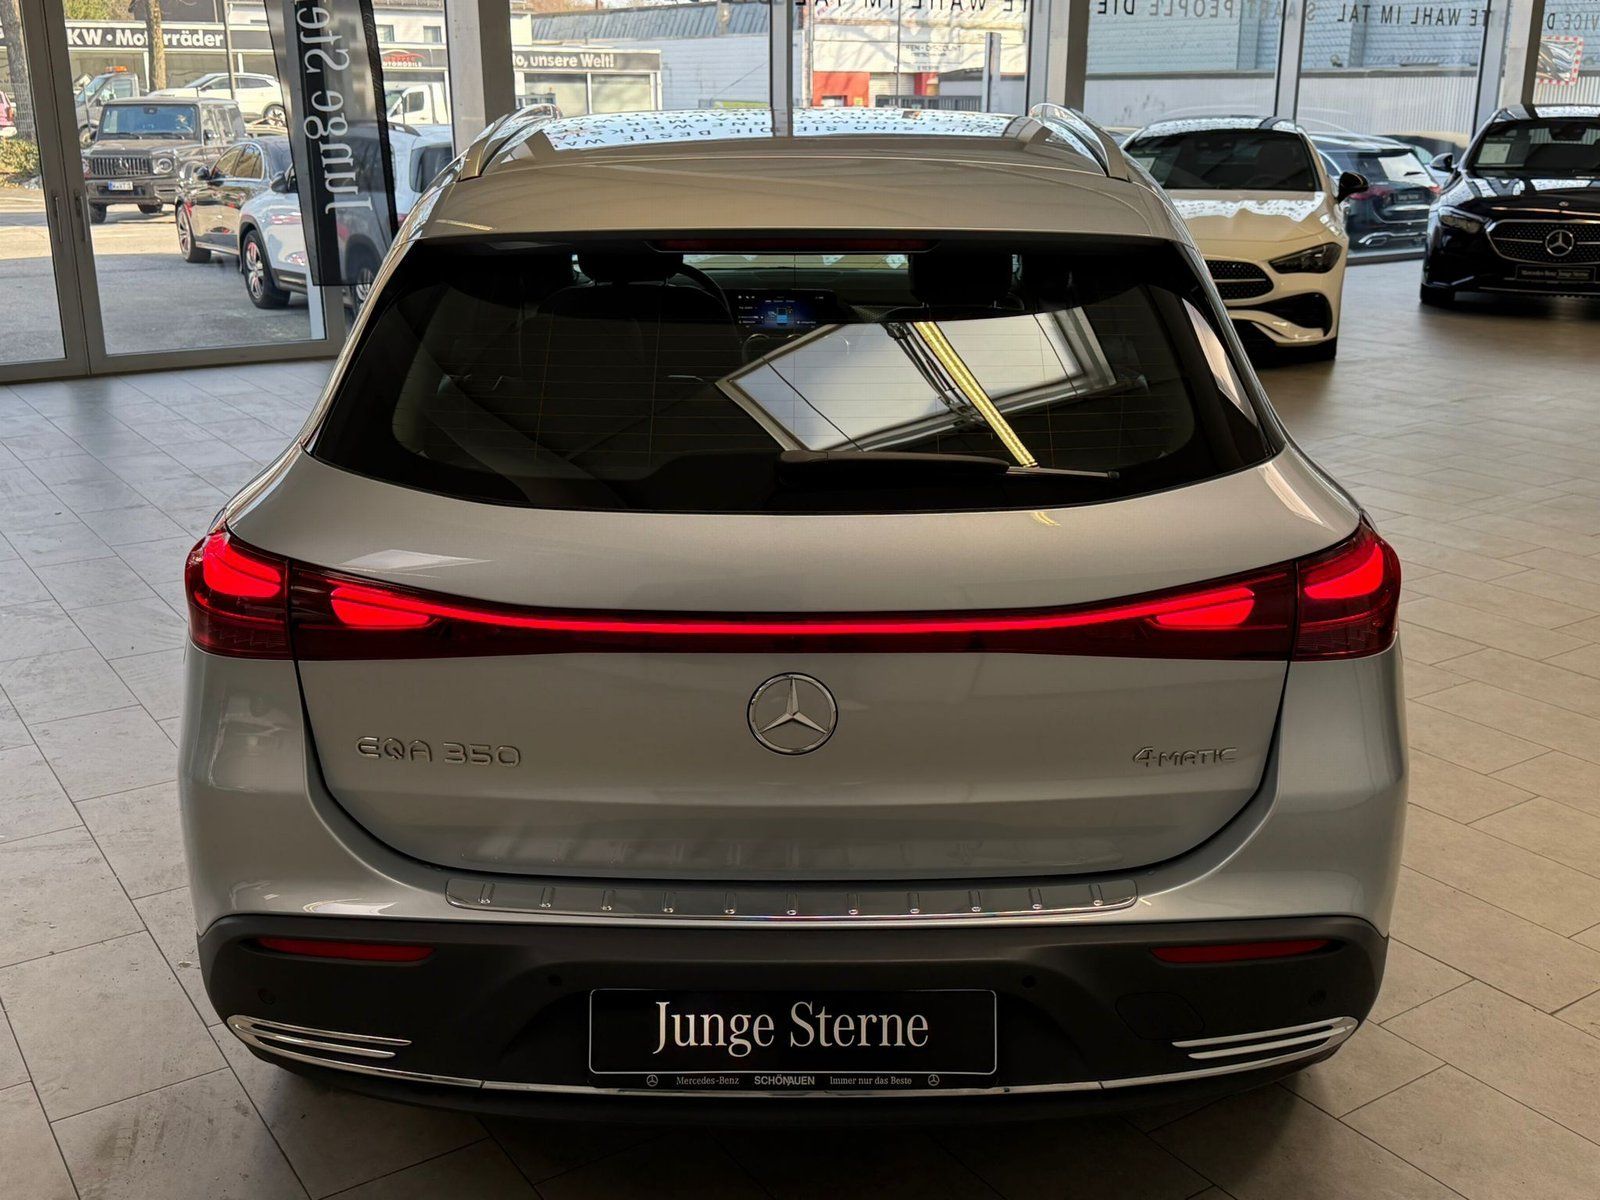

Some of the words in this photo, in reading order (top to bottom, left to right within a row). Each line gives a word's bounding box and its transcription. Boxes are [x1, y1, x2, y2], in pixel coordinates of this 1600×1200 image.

[116, 29, 224, 47] Motrräder
[530, 55, 578, 67] unsere
[580, 53, 615, 68] Welt!
[356, 736, 433, 763] EQA
[443, 742, 521, 768] 350
[1133, 747, 1237, 767] 4MATIC
[652, 1001, 775, 1058] Junge
[790, 1001, 929, 1048] Sterne
[676, 1076, 740, 1085] Mercedes-Benz
[754, 1074, 815, 1086] SCHÖNAUEN
[829, 1076, 856, 1085] Immer
[858, 1077, 874, 1085] nur
[875, 1076, 889, 1085] das
[890, 1076, 912, 1085] Beste
